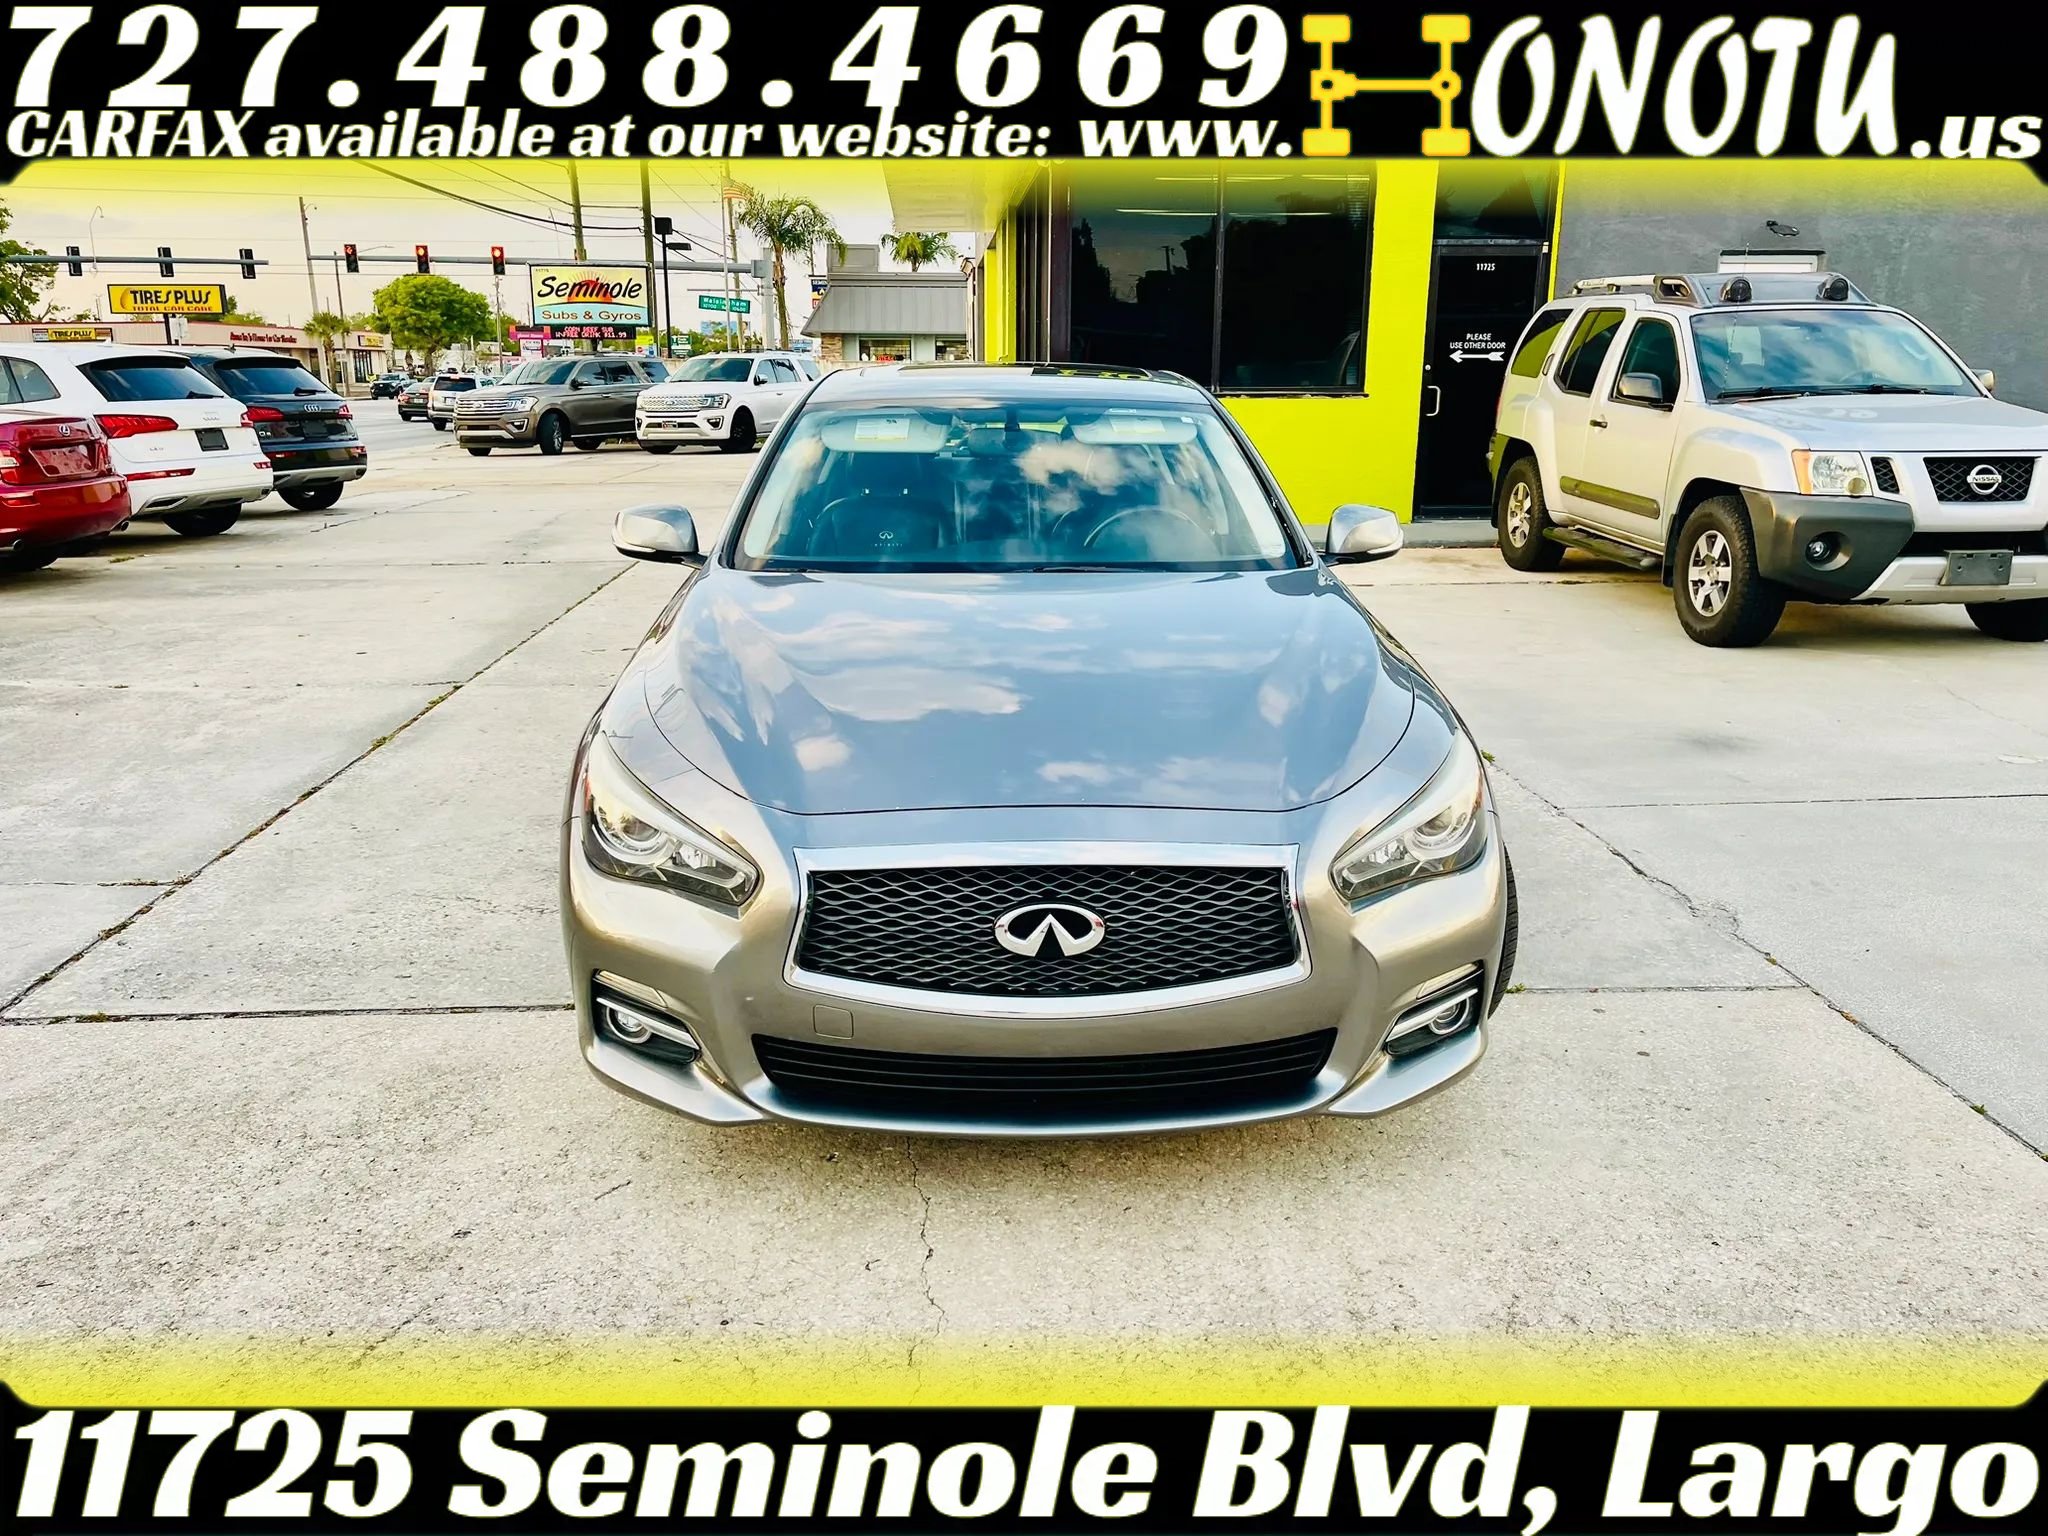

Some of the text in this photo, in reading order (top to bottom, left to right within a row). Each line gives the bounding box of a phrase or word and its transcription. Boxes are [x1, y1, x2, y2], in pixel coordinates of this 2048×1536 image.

[1476, 263, 1496, 271] 11725
[537, 276, 643, 299] Seminole
[130, 290, 211, 304] TIRES PLUS
[541, 310, 642, 322] Subs & Gyros
[1466, 333, 1492, 341] PLEASE
